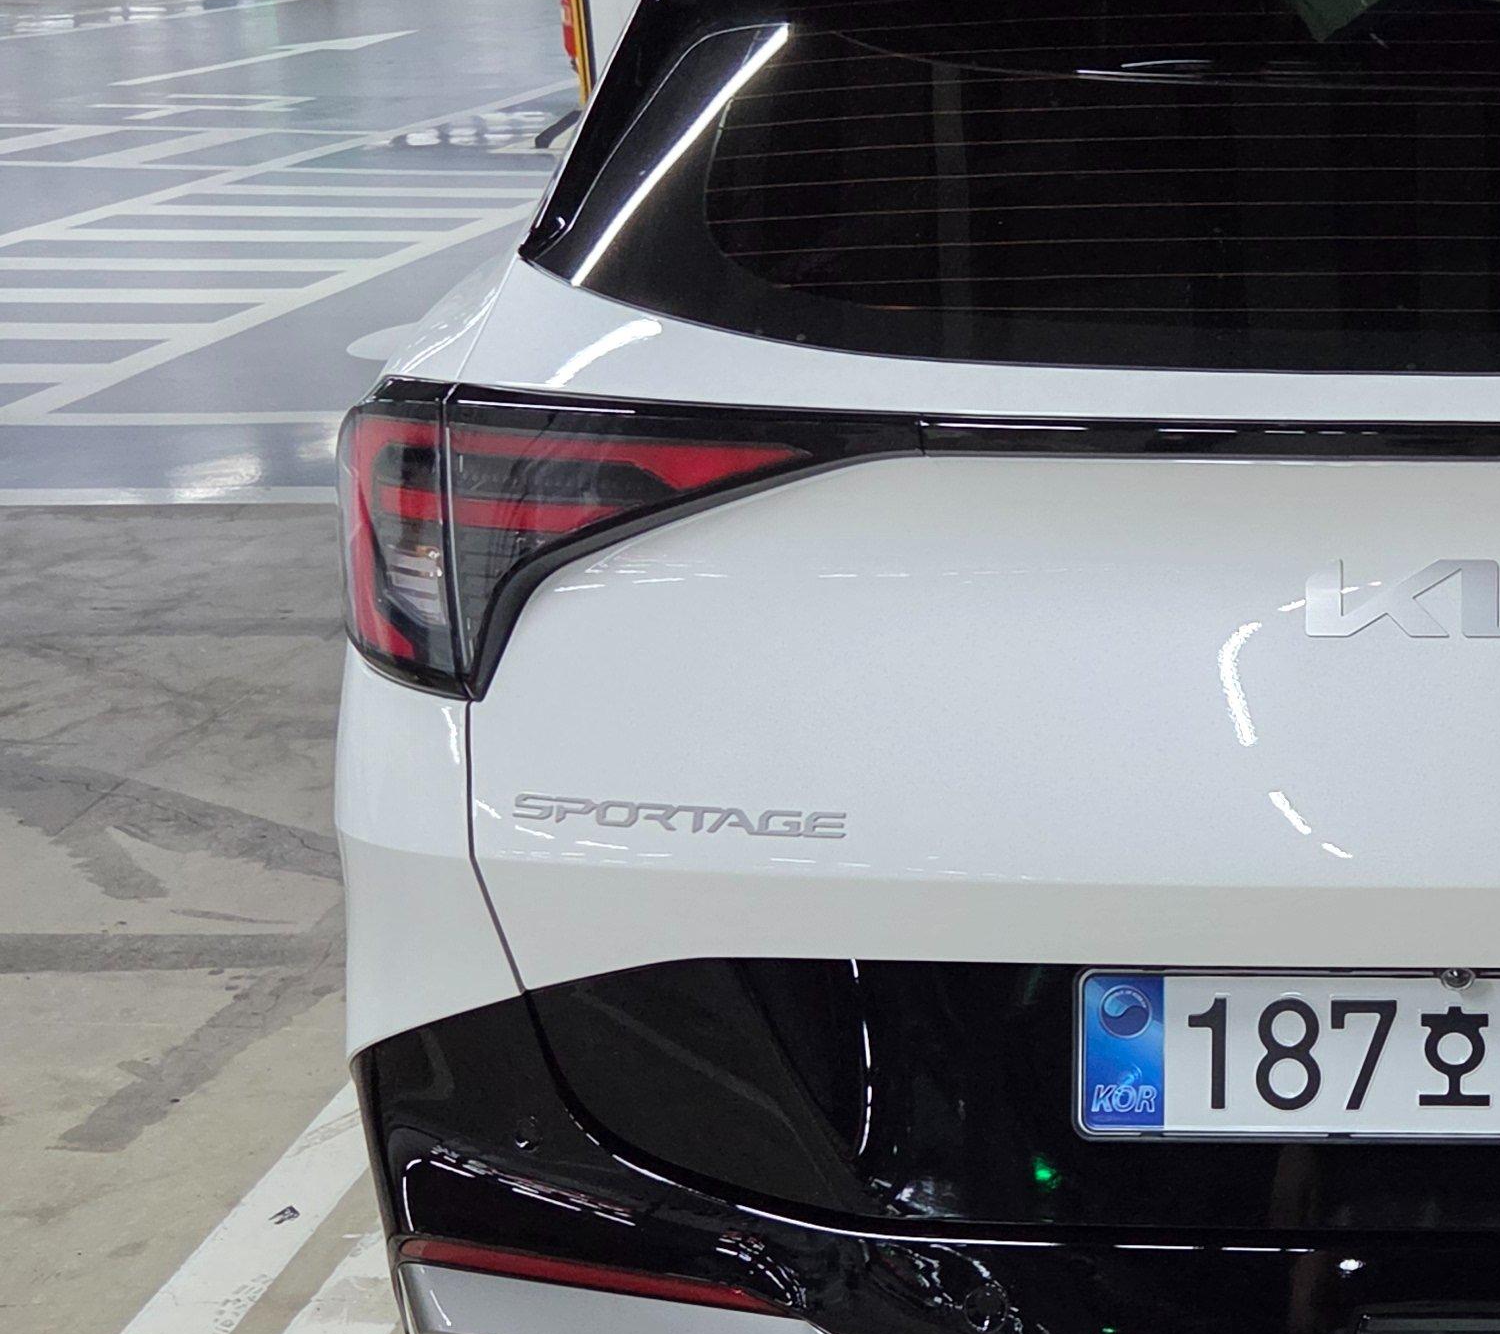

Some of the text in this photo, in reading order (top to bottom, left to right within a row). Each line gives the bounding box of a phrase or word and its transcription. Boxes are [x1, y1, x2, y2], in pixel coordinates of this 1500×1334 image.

[512, 792, 847, 839] SPORTAGE
[1187, 994, 1491, 1112] 187호
[1090, 1084, 1158, 1113] KOR
